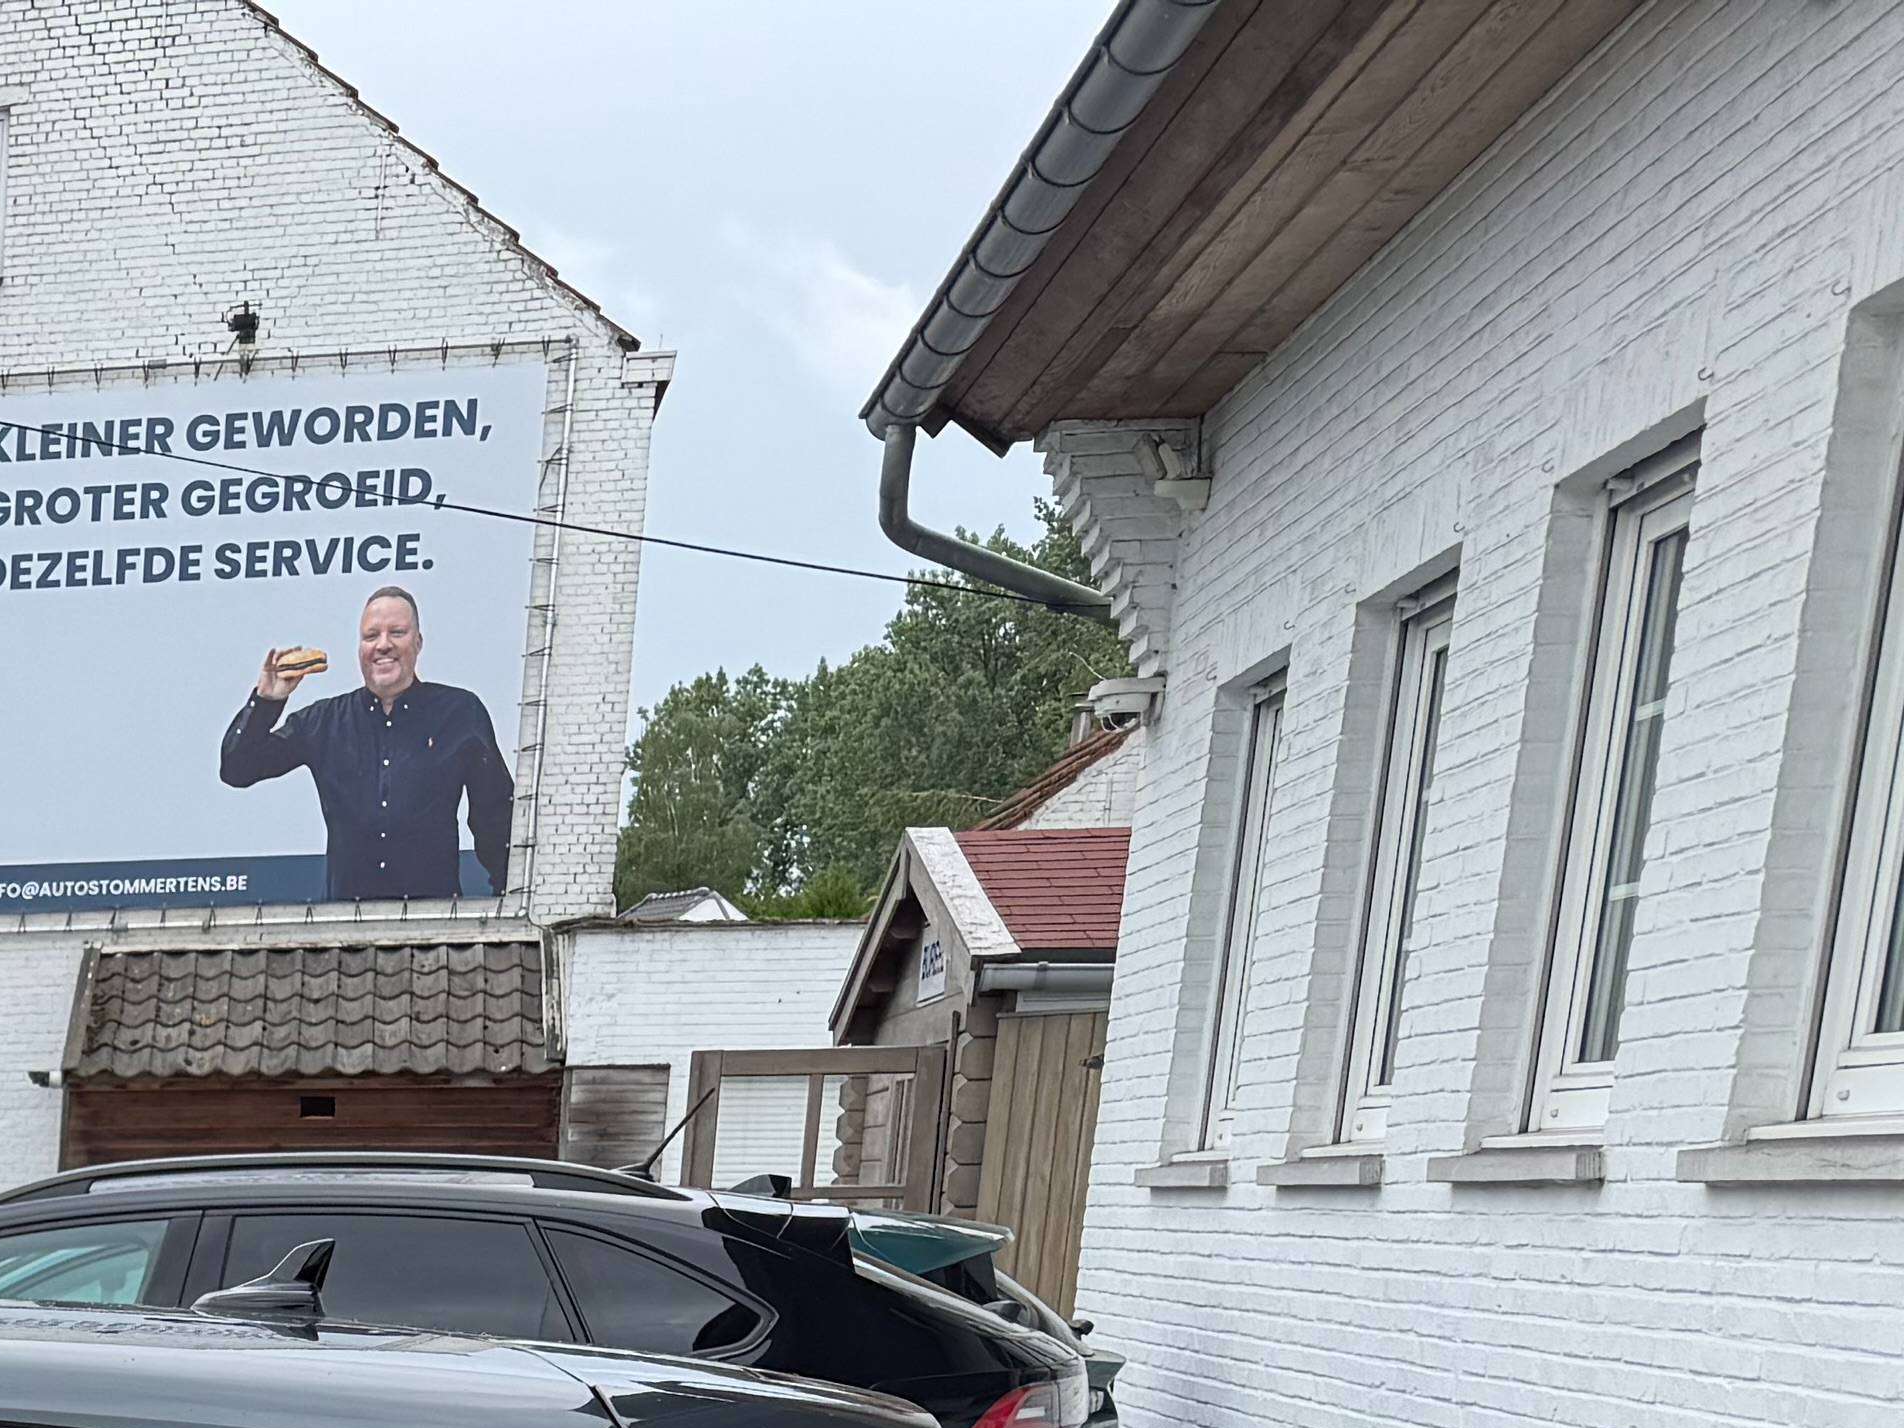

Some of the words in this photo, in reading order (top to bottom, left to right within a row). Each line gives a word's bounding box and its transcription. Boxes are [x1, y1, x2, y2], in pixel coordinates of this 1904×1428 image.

[185, 398, 493, 452] GEWORDEN,
[180, 467, 447, 518] GEGROEID,
[213, 533, 435, 580] SERVICE.
